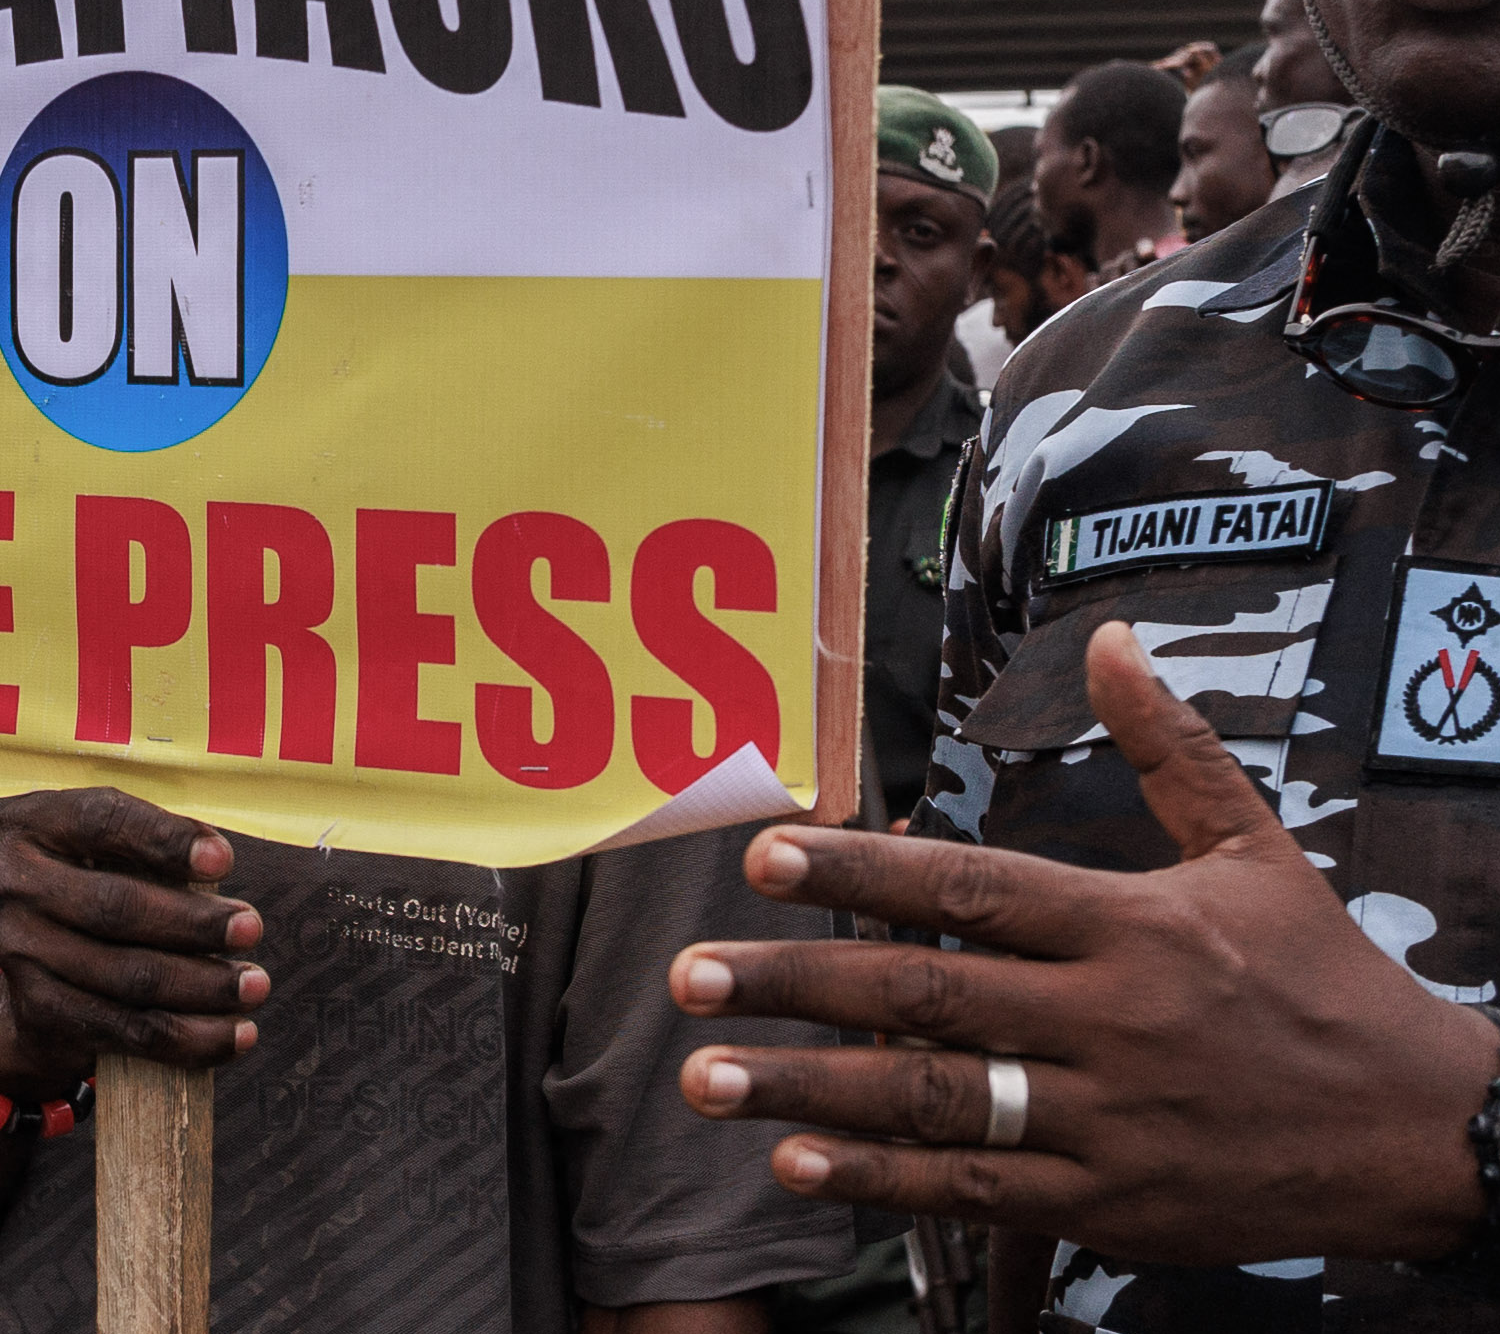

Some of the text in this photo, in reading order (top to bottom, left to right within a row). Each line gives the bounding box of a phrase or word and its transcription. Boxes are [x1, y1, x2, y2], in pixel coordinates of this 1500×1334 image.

[10, 147, 246, 388] ON
[1092, 496, 1316, 559] TIJANI FATAI
[74, 494, 781, 792] PRESS
[403, 898, 446, 924] Out
[431, 934, 484, 960] Dent
